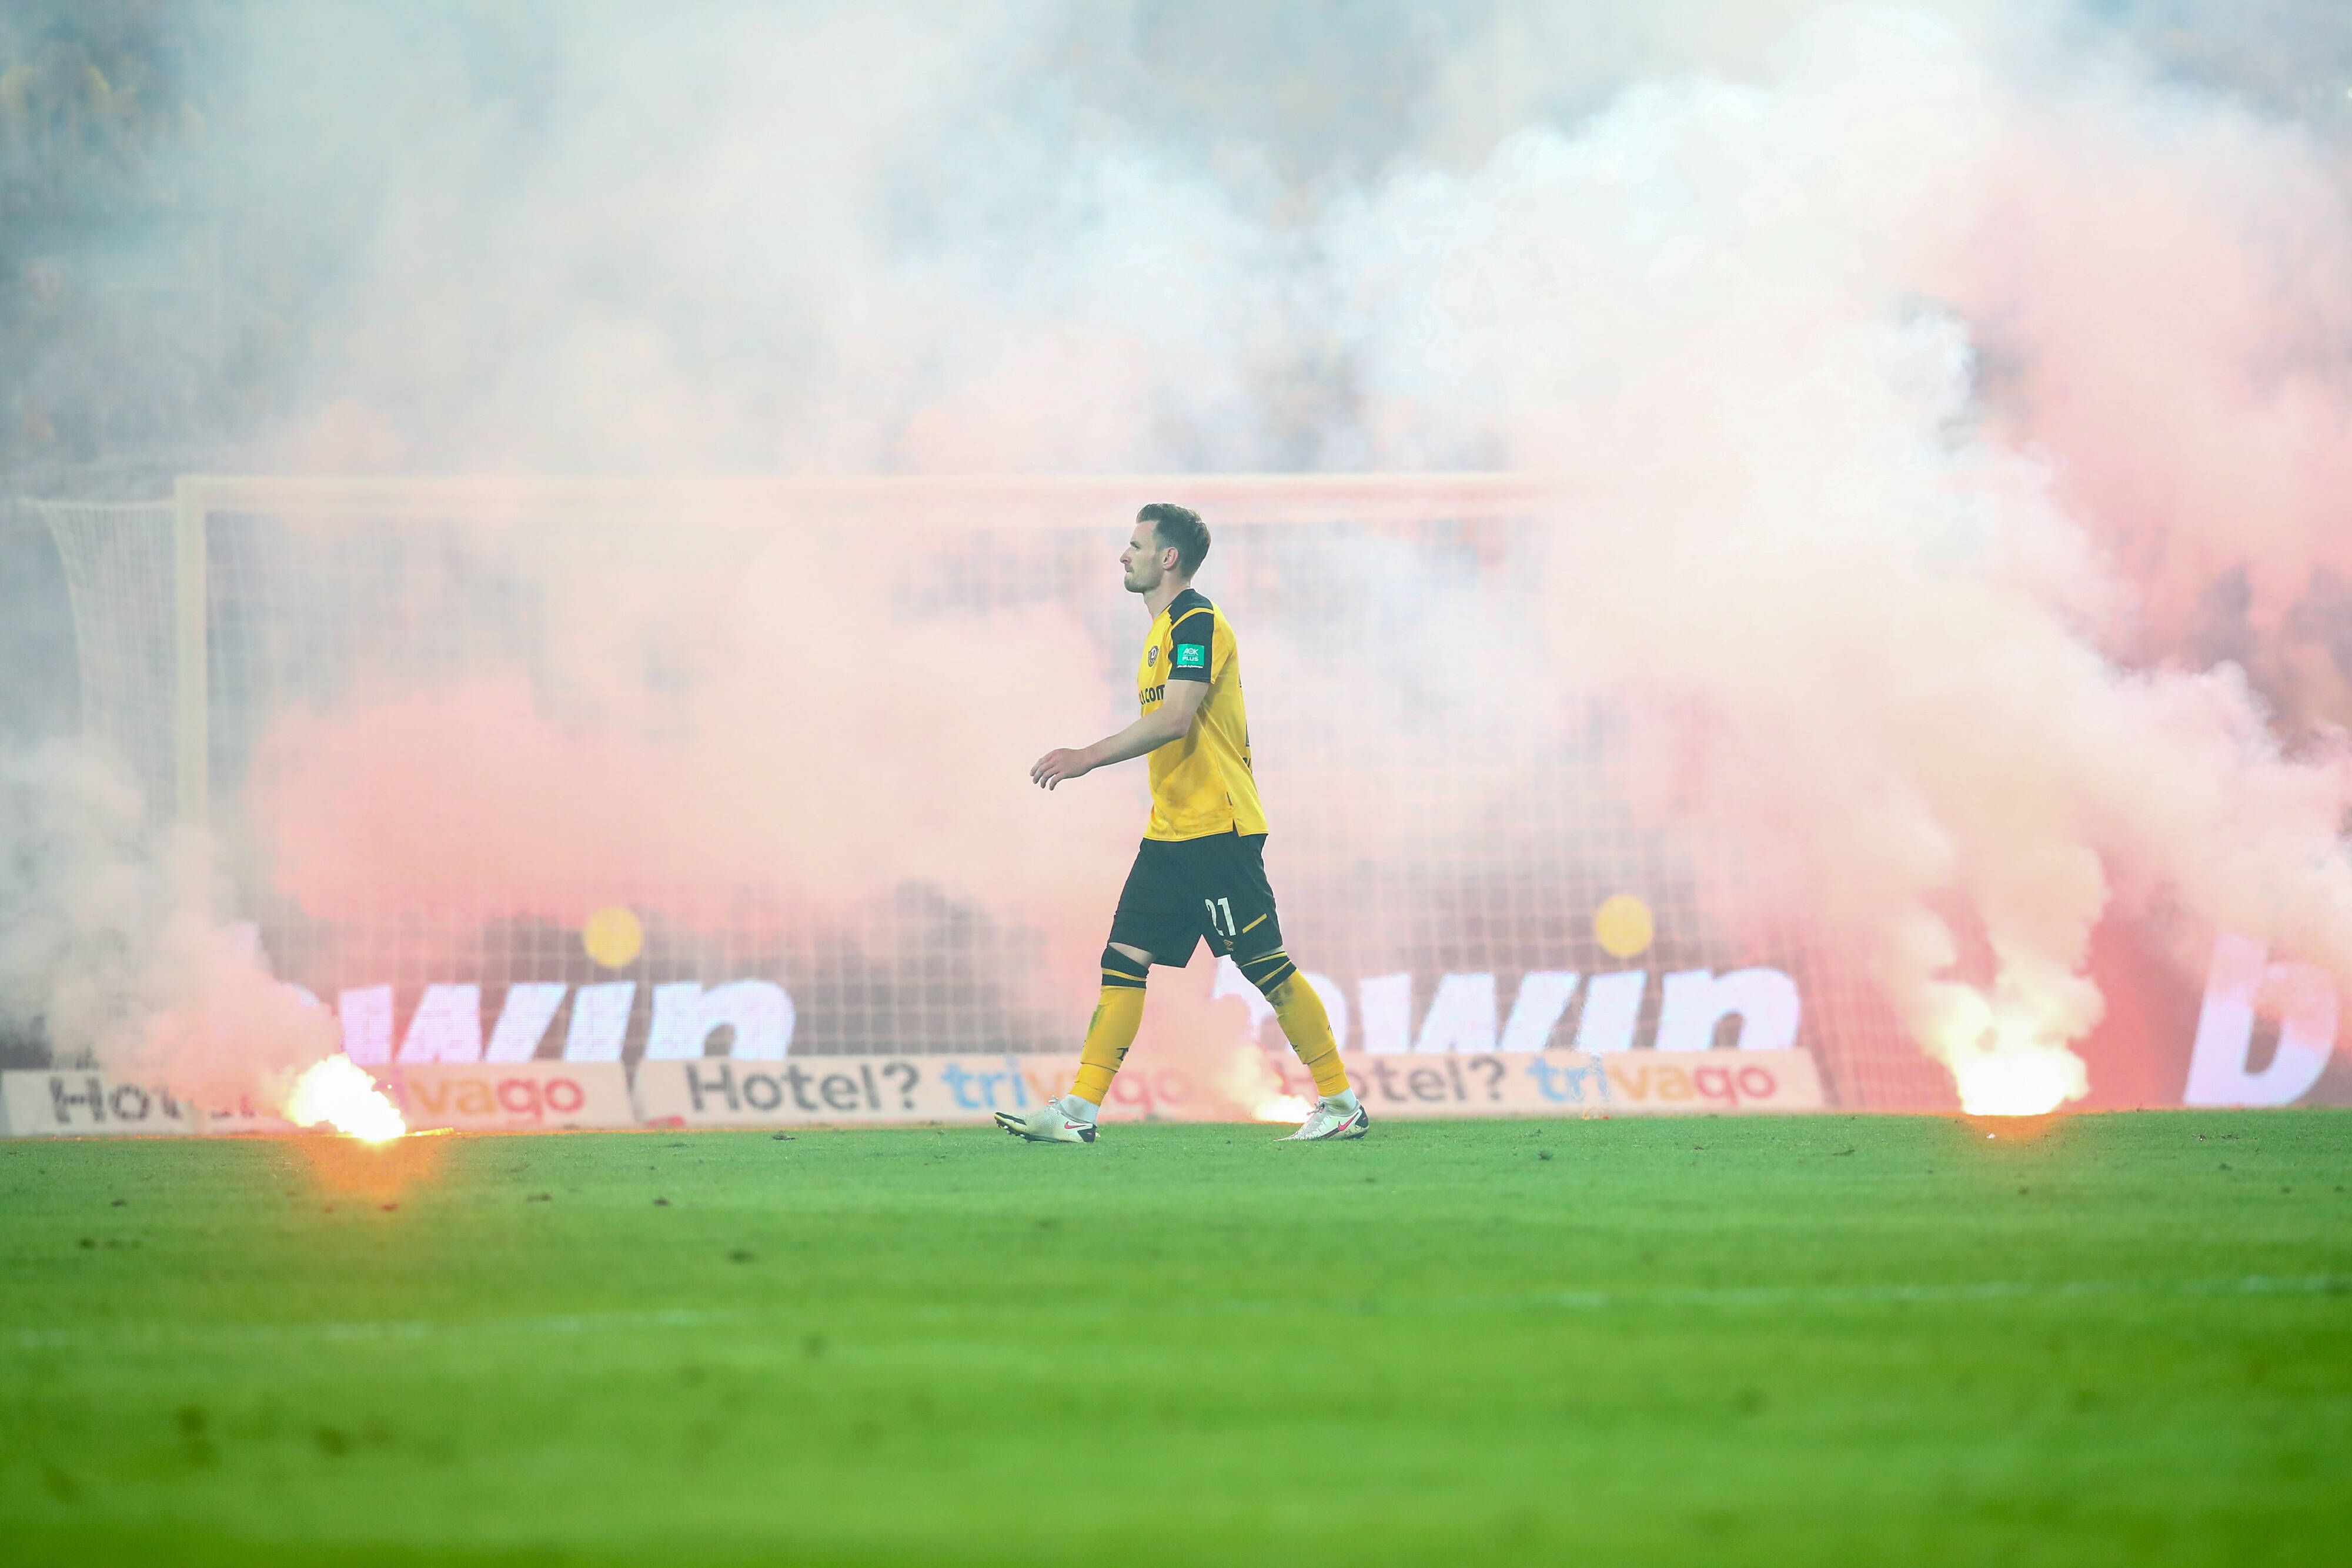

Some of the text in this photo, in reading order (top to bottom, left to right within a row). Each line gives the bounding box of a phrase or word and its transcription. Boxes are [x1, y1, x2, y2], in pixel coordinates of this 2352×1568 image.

[1183, 647, 1199, 656] AOK
[1205, 897, 1236, 936] 21
[297, 979, 796, 1064] win
[684, 1056, 1192, 1116] Hotel? trivgo
[1525, 1055, 1777, 1109] trivago
